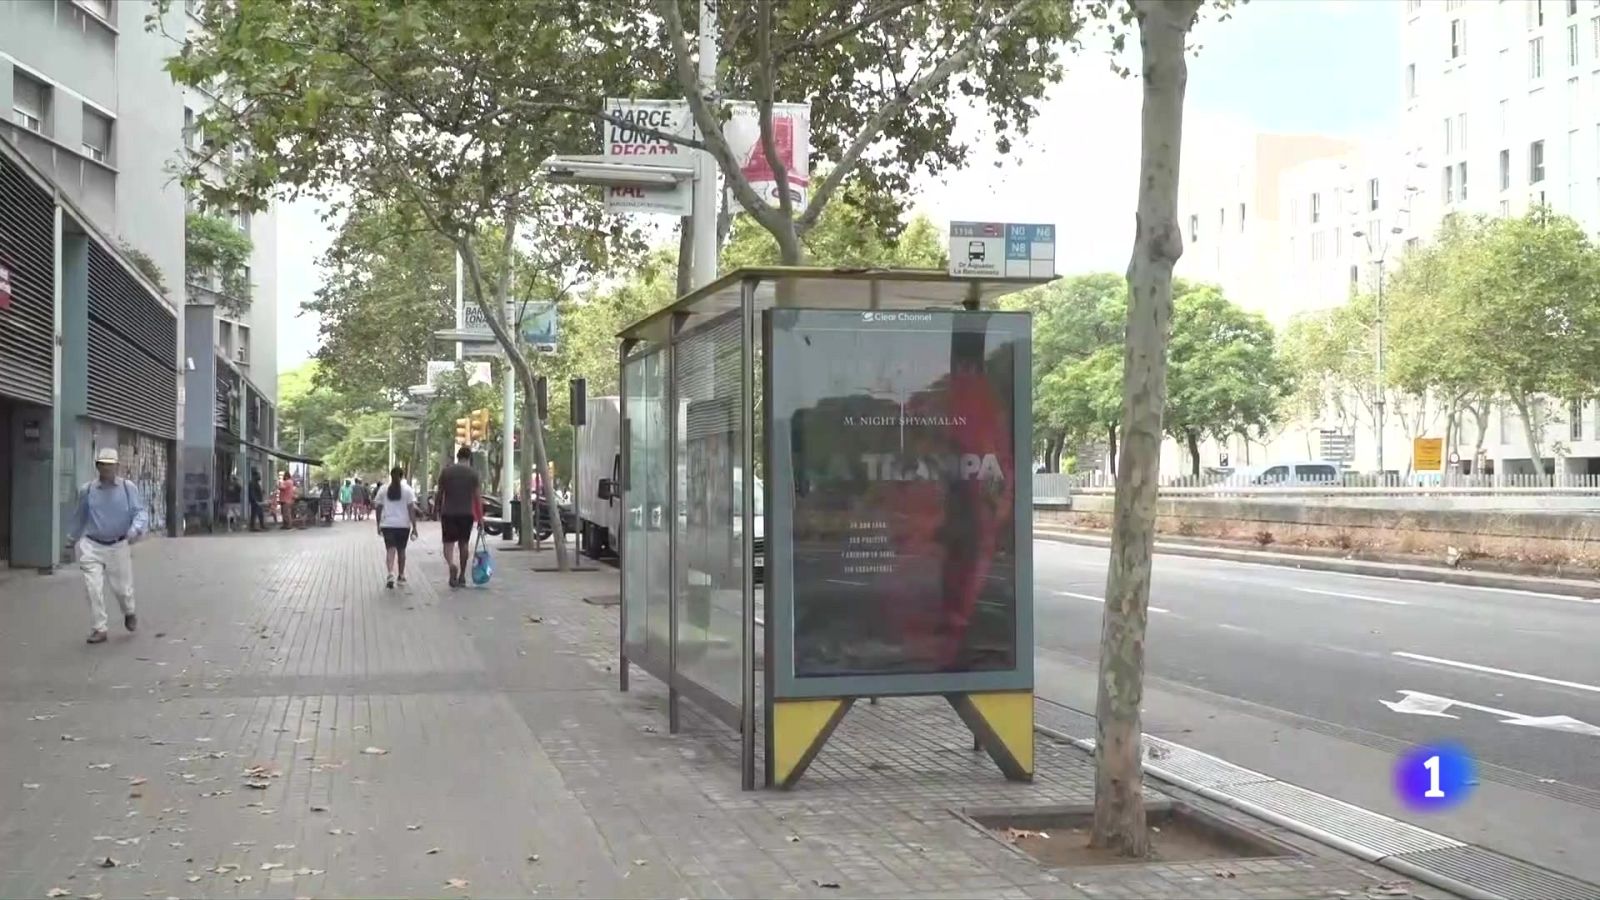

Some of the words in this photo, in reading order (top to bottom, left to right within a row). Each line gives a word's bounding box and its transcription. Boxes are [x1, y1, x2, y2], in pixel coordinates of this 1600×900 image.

[874, 312, 896, 321] Clear
[898, 312, 932, 322] Channel
[860, 416, 896, 426] NIGHT
[899, 416, 967, 426] SHYAMALAN
